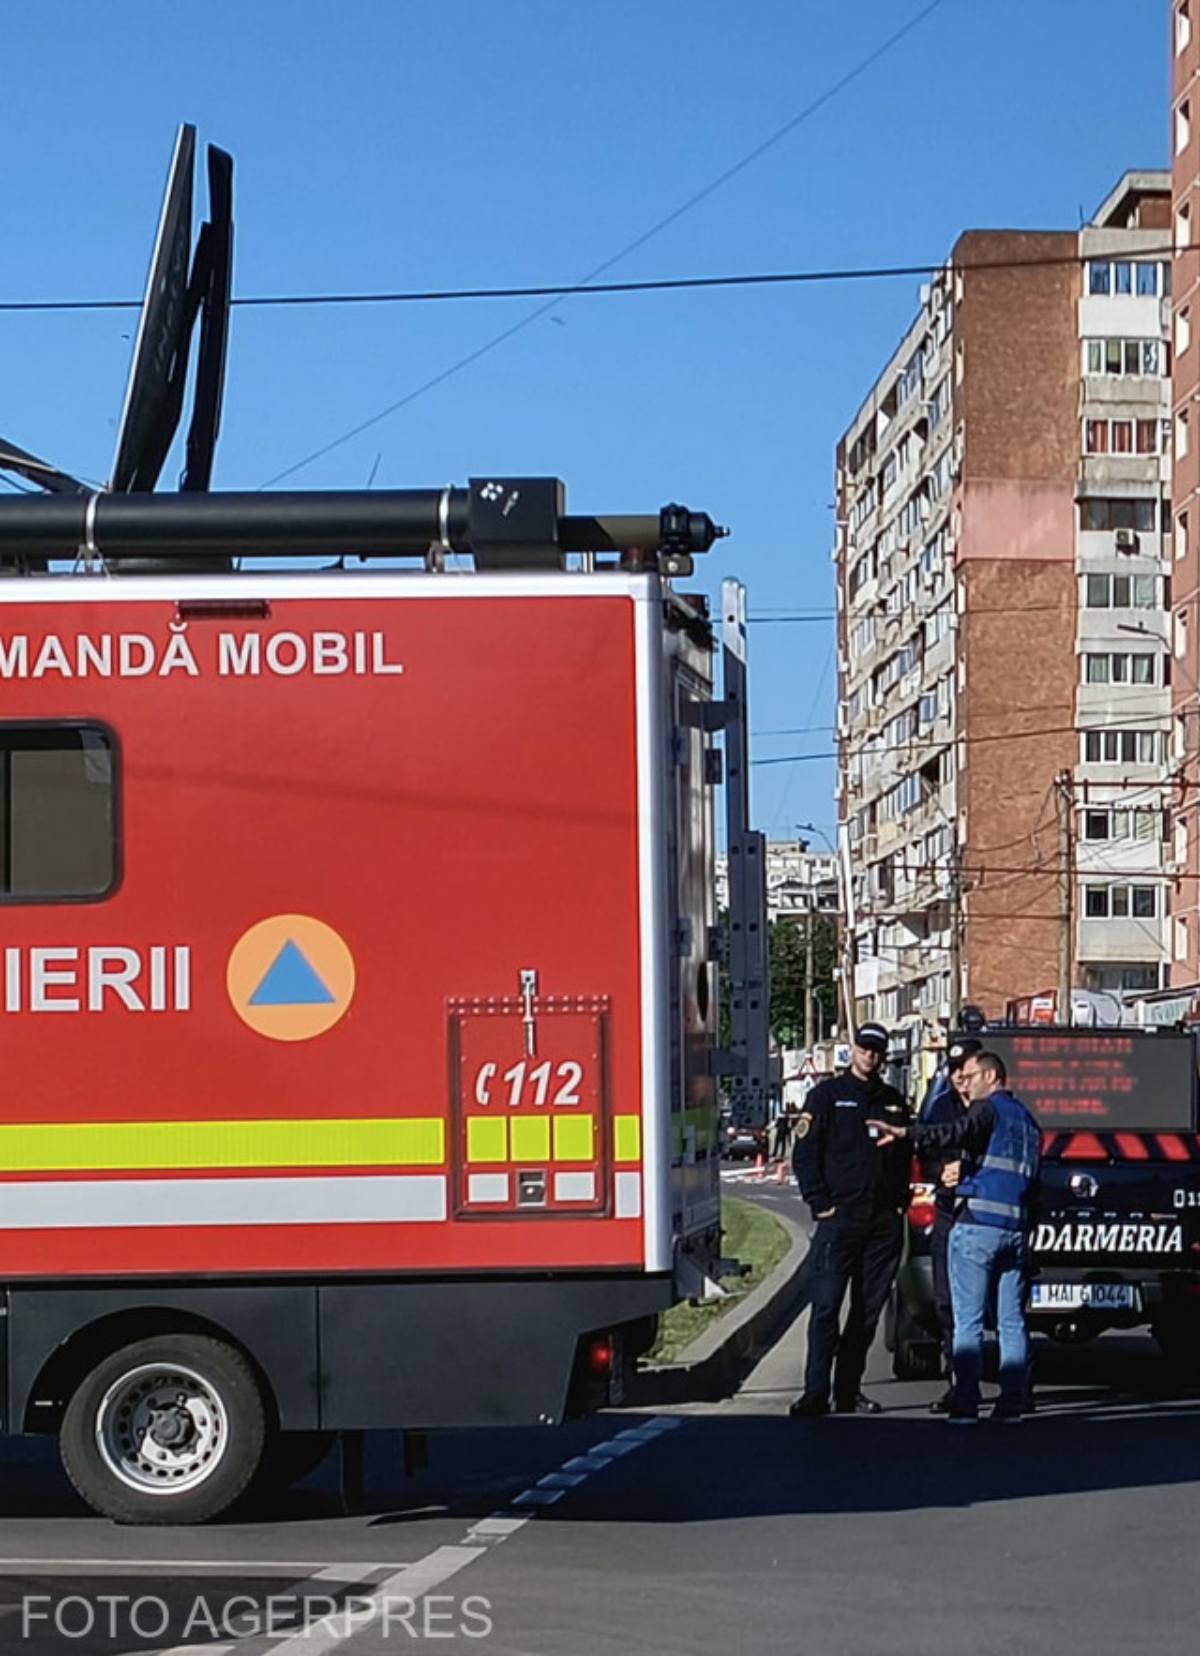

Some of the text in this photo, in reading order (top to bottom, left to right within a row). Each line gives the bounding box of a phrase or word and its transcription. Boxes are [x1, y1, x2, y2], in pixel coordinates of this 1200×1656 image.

[218, 632, 403, 675] MOBIL
[5, 946, 190, 1012] IERII
[503, 1060, 582, 1105] 112
[1029, 1224, 1183, 1252] DARMERIA
